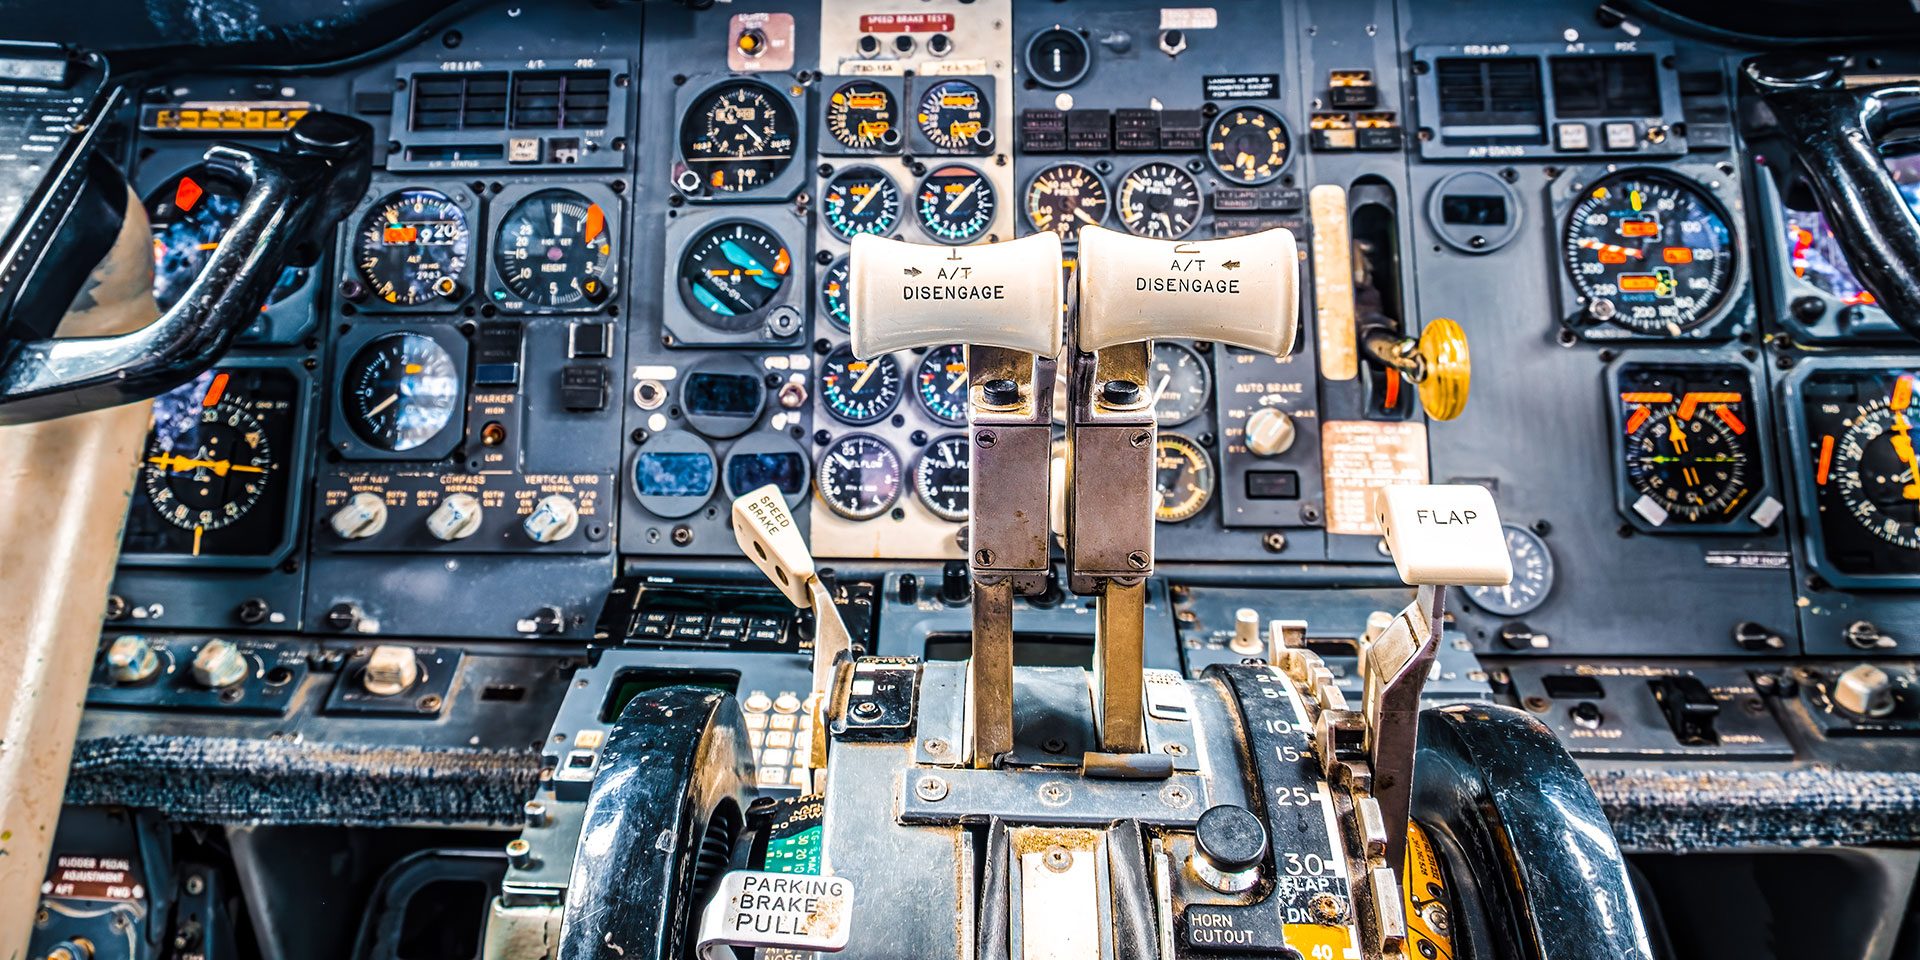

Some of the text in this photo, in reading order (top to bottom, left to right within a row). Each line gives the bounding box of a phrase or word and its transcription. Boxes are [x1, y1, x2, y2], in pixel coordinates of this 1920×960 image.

[868, 15, 947, 24] SPEED BRAKE TEST
[1146, 187, 1172, 195] PRESS
[413, 202, 424, 214] 0
[434, 223, 456, 238] 20
[519, 224, 533, 236] 25
[516, 236, 529, 248] 20
[516, 248, 528, 260] 15
[541, 262, 567, 273] HEIGHT
[585, 263, 593, 274] 3
[1170, 259, 1206, 273] A/T
[520, 268, 532, 280] 10
[937, 267, 972, 280] A/T
[570, 277, 578, 289] 4
[1135, 277, 1241, 295] DISENGAGE
[902, 285, 1005, 301] DISENGAGE
[505, 301, 523, 310] TEST
[1237, 355, 1256, 364] OFF
[1274, 355, 1293, 364] OFF
[1235, 383, 1303, 393] AUTO BRAKE
[474, 394, 515, 404] MARKER
[485, 406, 505, 415] HIGH
[1225, 428, 1244, 437] OFF
[842, 447, 856, 457] 05
[485, 453, 503, 463] LOW
[860, 460, 883, 468] FLOW
[440, 475, 486, 486] COMPASS
[524, 475, 599, 485] VERTICAL GYRO
[352, 485, 384, 493] NORMAL
[386, 490, 408, 499] BOTH
[416, 490, 439, 499] BOTH
[445, 485, 479, 493] NORMAL
[482, 490, 505, 499] BOTH
[515, 490, 537, 499] CAPT
[541, 485, 575, 494] NORMAL
[578, 490, 598, 499] F/O
[834, 485, 841, 495] 6
[930, 486, 938, 496] 6
[326, 491, 348, 499] BOTH
[417, 499, 429, 507] ON
[483, 499, 495, 507] ON
[851, 498, 858, 507] 5
[948, 499, 955, 508] 5
[516, 507, 534, 515] AUX
[578, 507, 596, 515] AUX
[760, 496, 790, 528] SPEED
[748, 502, 780, 536] BRAKE
[1416, 509, 1477, 525] FLAP
[685, 616, 703, 624] WPT
[719, 629, 736, 637] AUX
[877, 684, 896, 692] UP
[1264, 688, 1277, 698] 5
[1266, 719, 1292, 734] 10
[1275, 746, 1300, 762] 15
[1275, 787, 1310, 806] 25
[797, 834, 809, 845] 30
[795, 848, 808, 860] 20
[58, 856, 130, 871] RUDDER PEDAL
[807, 856, 817, 874] MAC
[1284, 852, 1323, 877] 30
[62, 870, 125, 883] ADJUSTMENT
[54, 883, 74, 896] AFT
[743, 876, 843, 897] PARKING
[1282, 876, 1330, 892] FLAP
[106, 886, 131, 899] FWD
[740, 894, 818, 914] BRAKE
[735, 912, 809, 936] PULL
[1191, 913, 1233, 928] HORN
[1193, 930, 1254, 945] CUTOUT
[1311, 944, 1333, 960] 40
